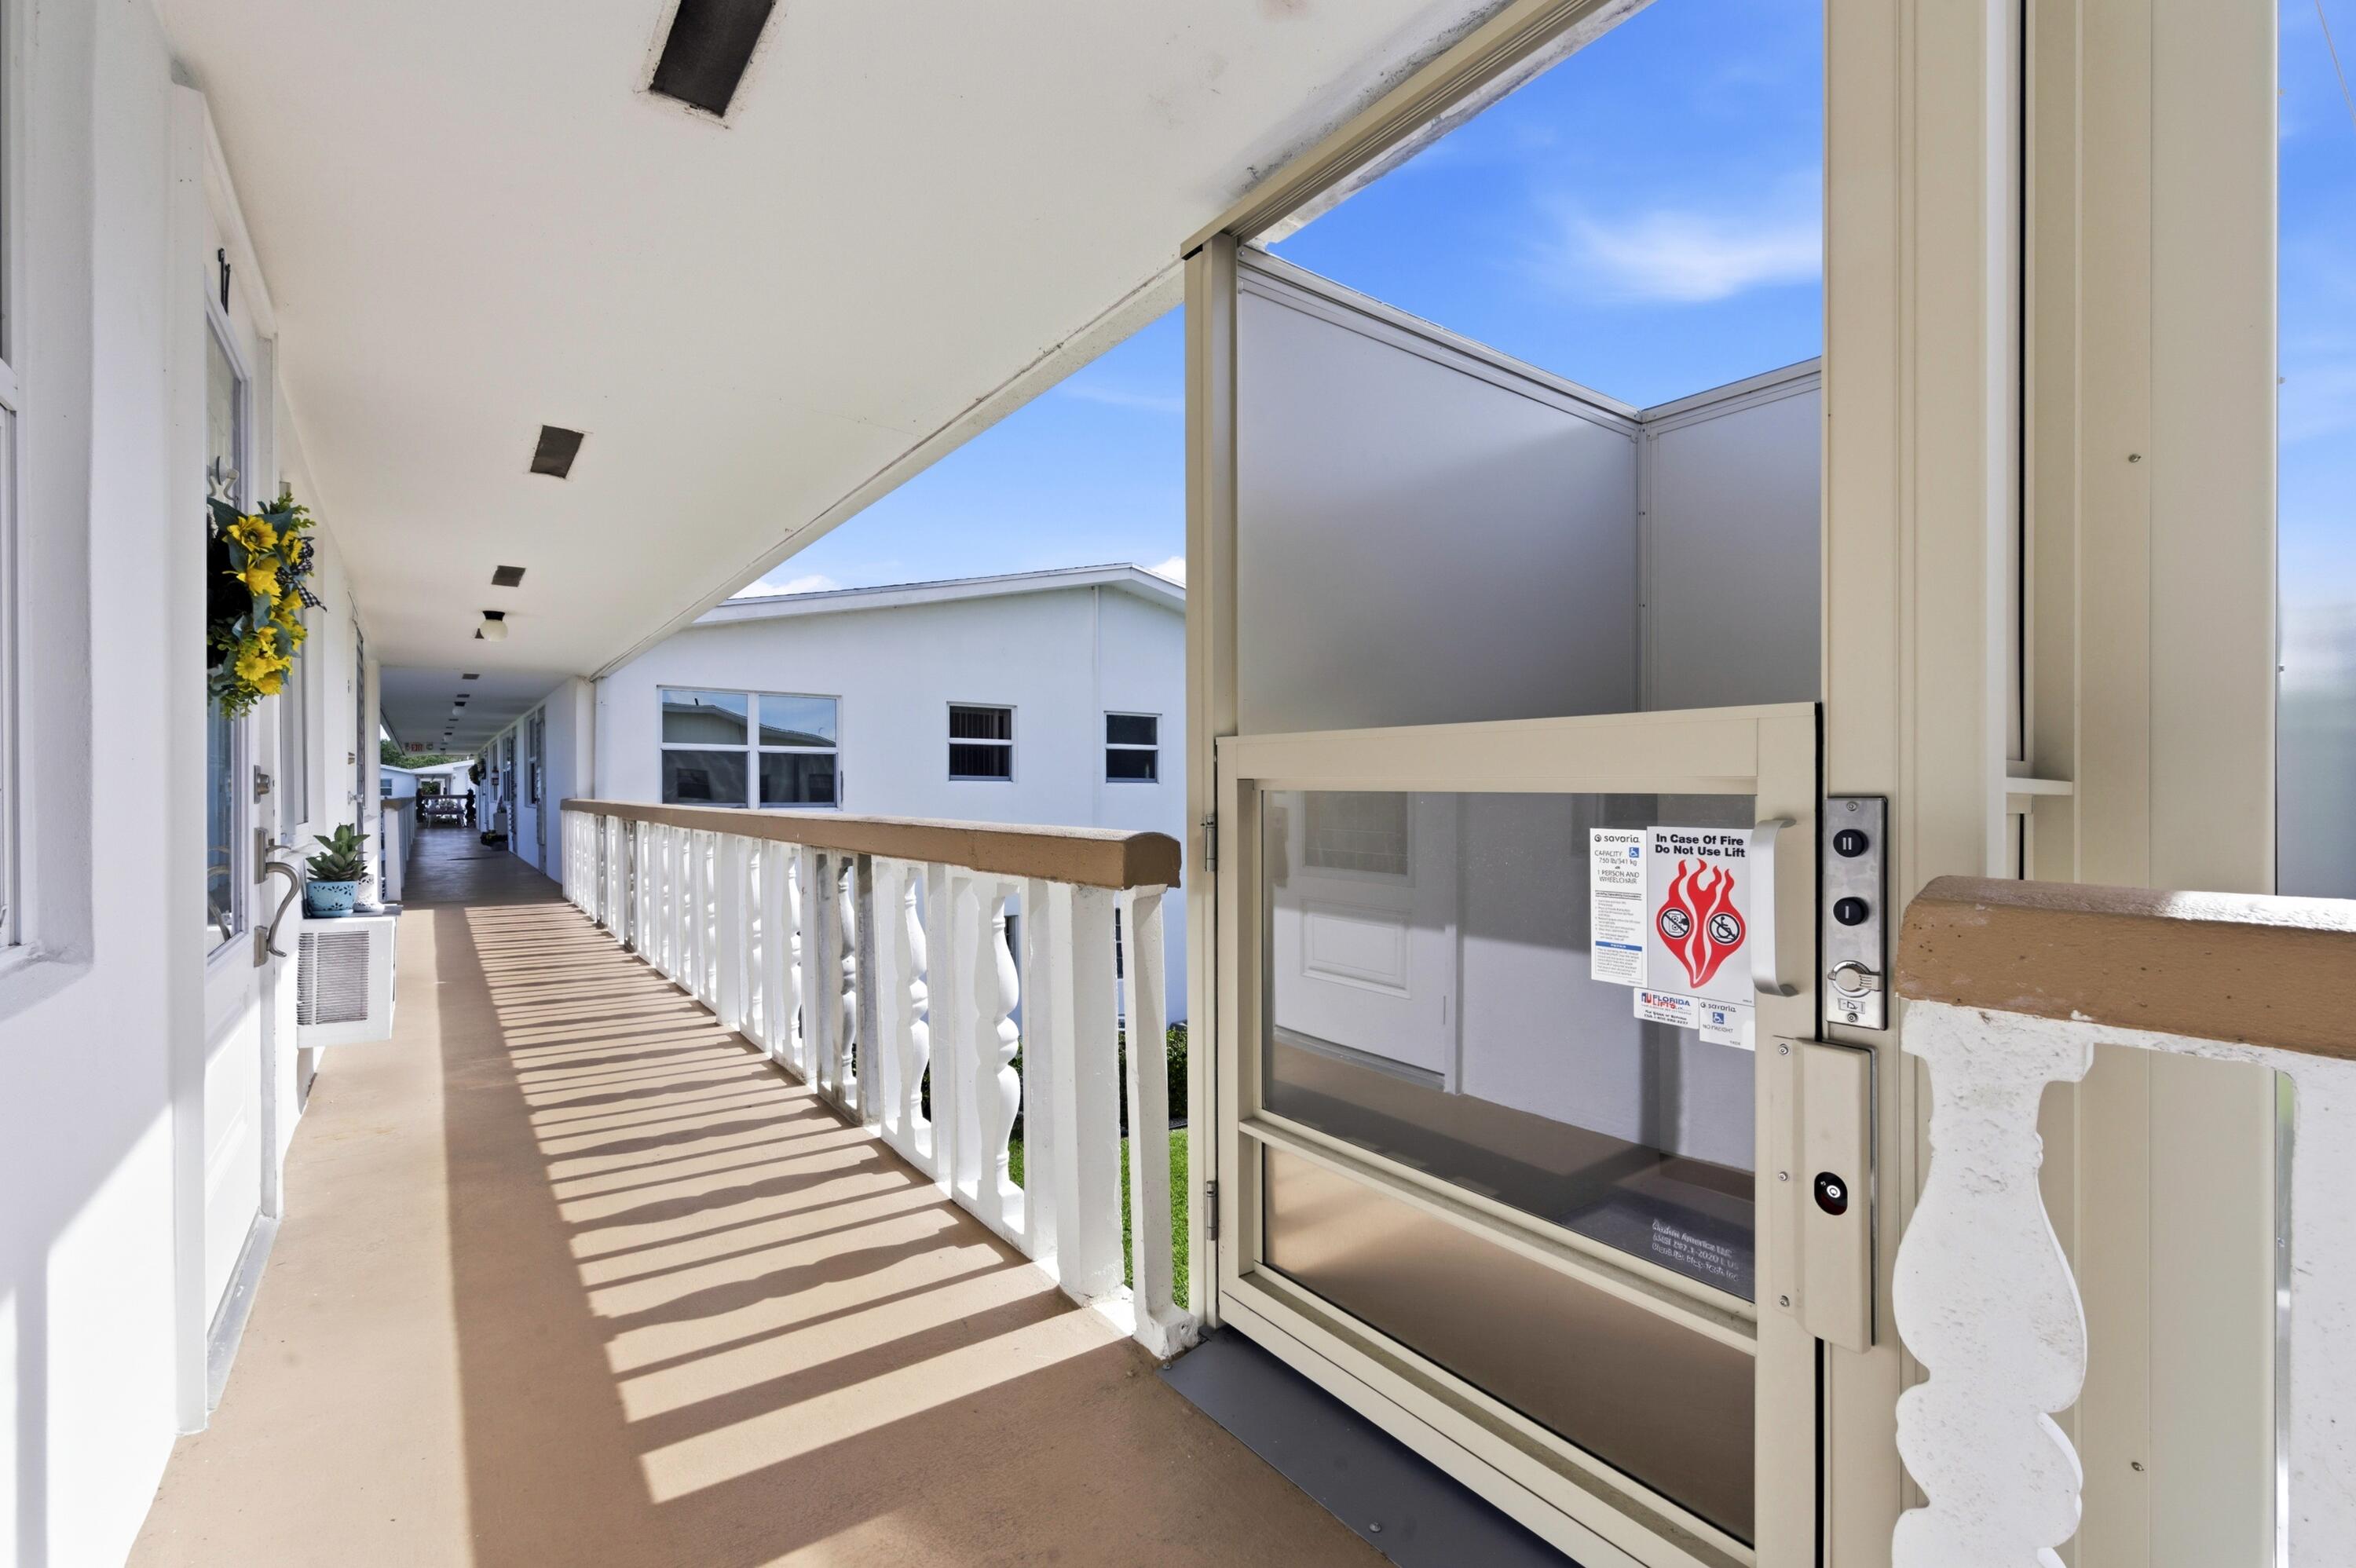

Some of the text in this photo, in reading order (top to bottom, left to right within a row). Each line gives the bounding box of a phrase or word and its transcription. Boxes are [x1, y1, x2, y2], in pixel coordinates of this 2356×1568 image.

[1604, 835, 1640, 843] savaria
[1656, 834, 1743, 846] In Case Of Fire
[1655, 844, 1745, 857] Do Not Use Lift
[1653, 994, 1690, 1006] FLORIDA
